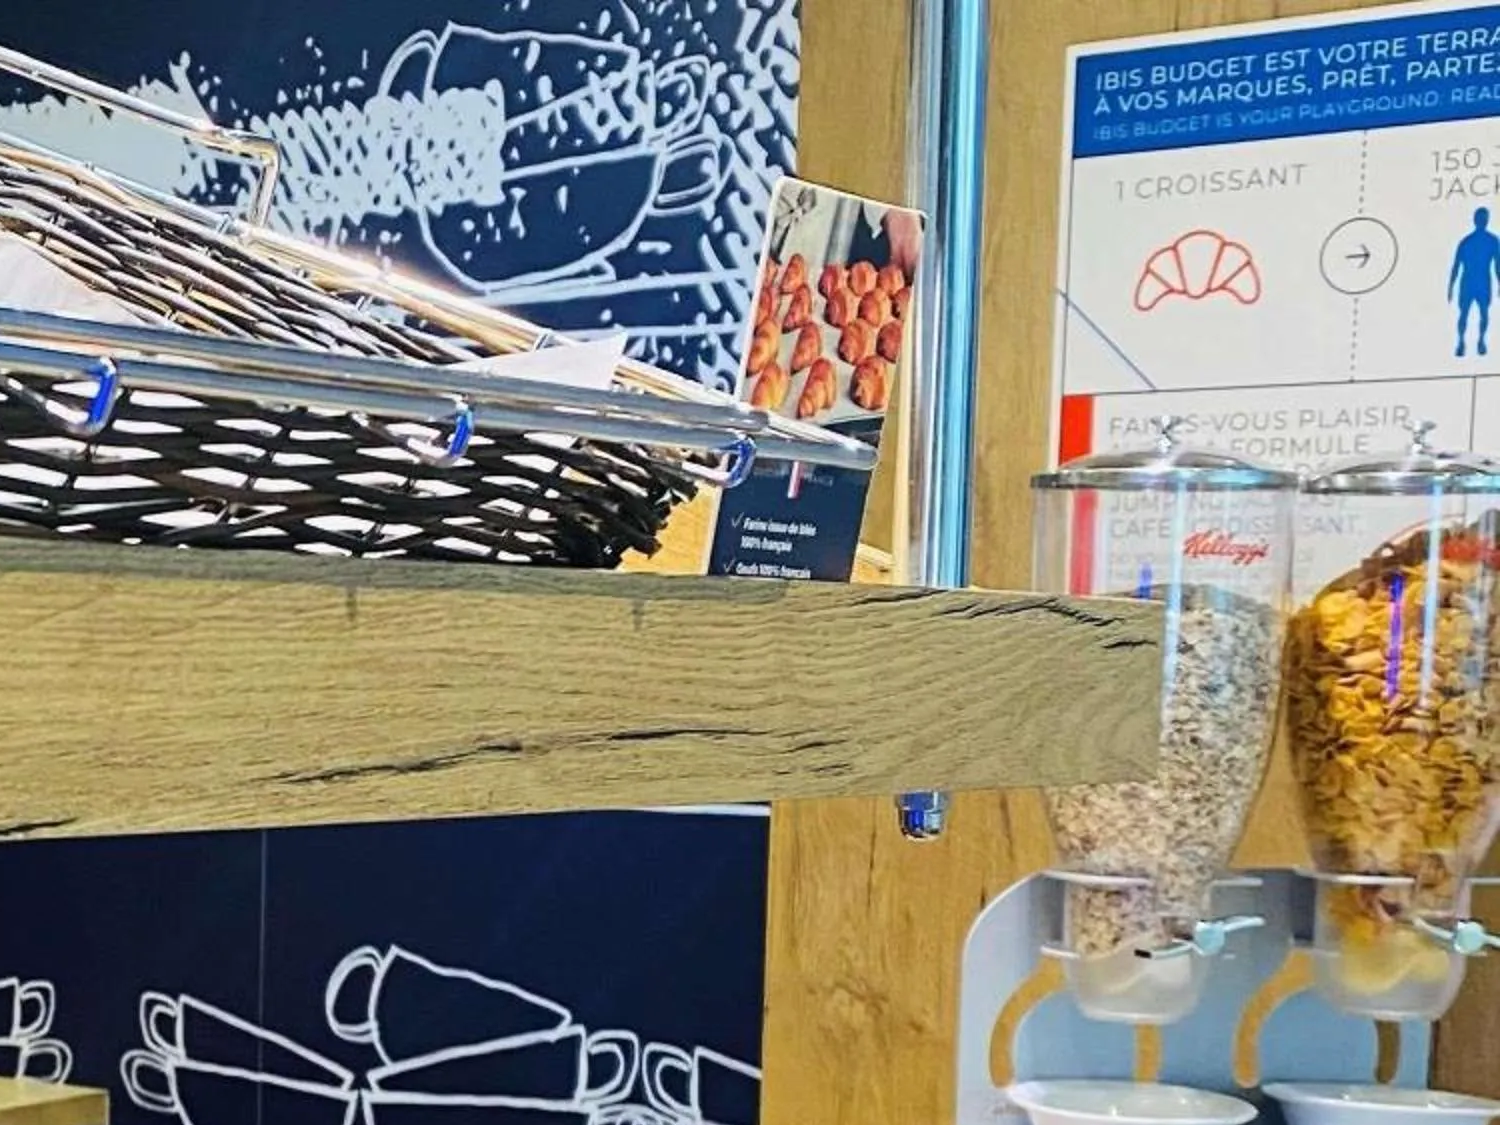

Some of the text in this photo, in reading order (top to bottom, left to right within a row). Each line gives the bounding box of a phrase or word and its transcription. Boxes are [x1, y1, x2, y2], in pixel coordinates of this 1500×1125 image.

[1095, 68, 1143, 92] IBIS
[1150, 55, 1257, 85] BUDGET
[1264, 48, 1311, 73] EST
[1318, 37, 1408, 66] VOTRE
[1118, 89, 1169, 113] VOS
[1176, 74, 1314, 107] MARQUES,
[1322, 61, 1397, 91] PRÊT,
[1406, 52, 1500, 82] PARTE
[1092, 122, 1128, 141] IBIS
[1133, 113, 1211, 138] BUDGET
[1216, 111, 1233, 128] IS
[1237, 105, 1294, 125] YOUR
[1431, 146, 1482, 173] 150
[1134, 163, 1308, 200] CROISSANT
[1428, 174, 1500, 201] JAC
[1230, 433, 1371, 458] FORMULE
